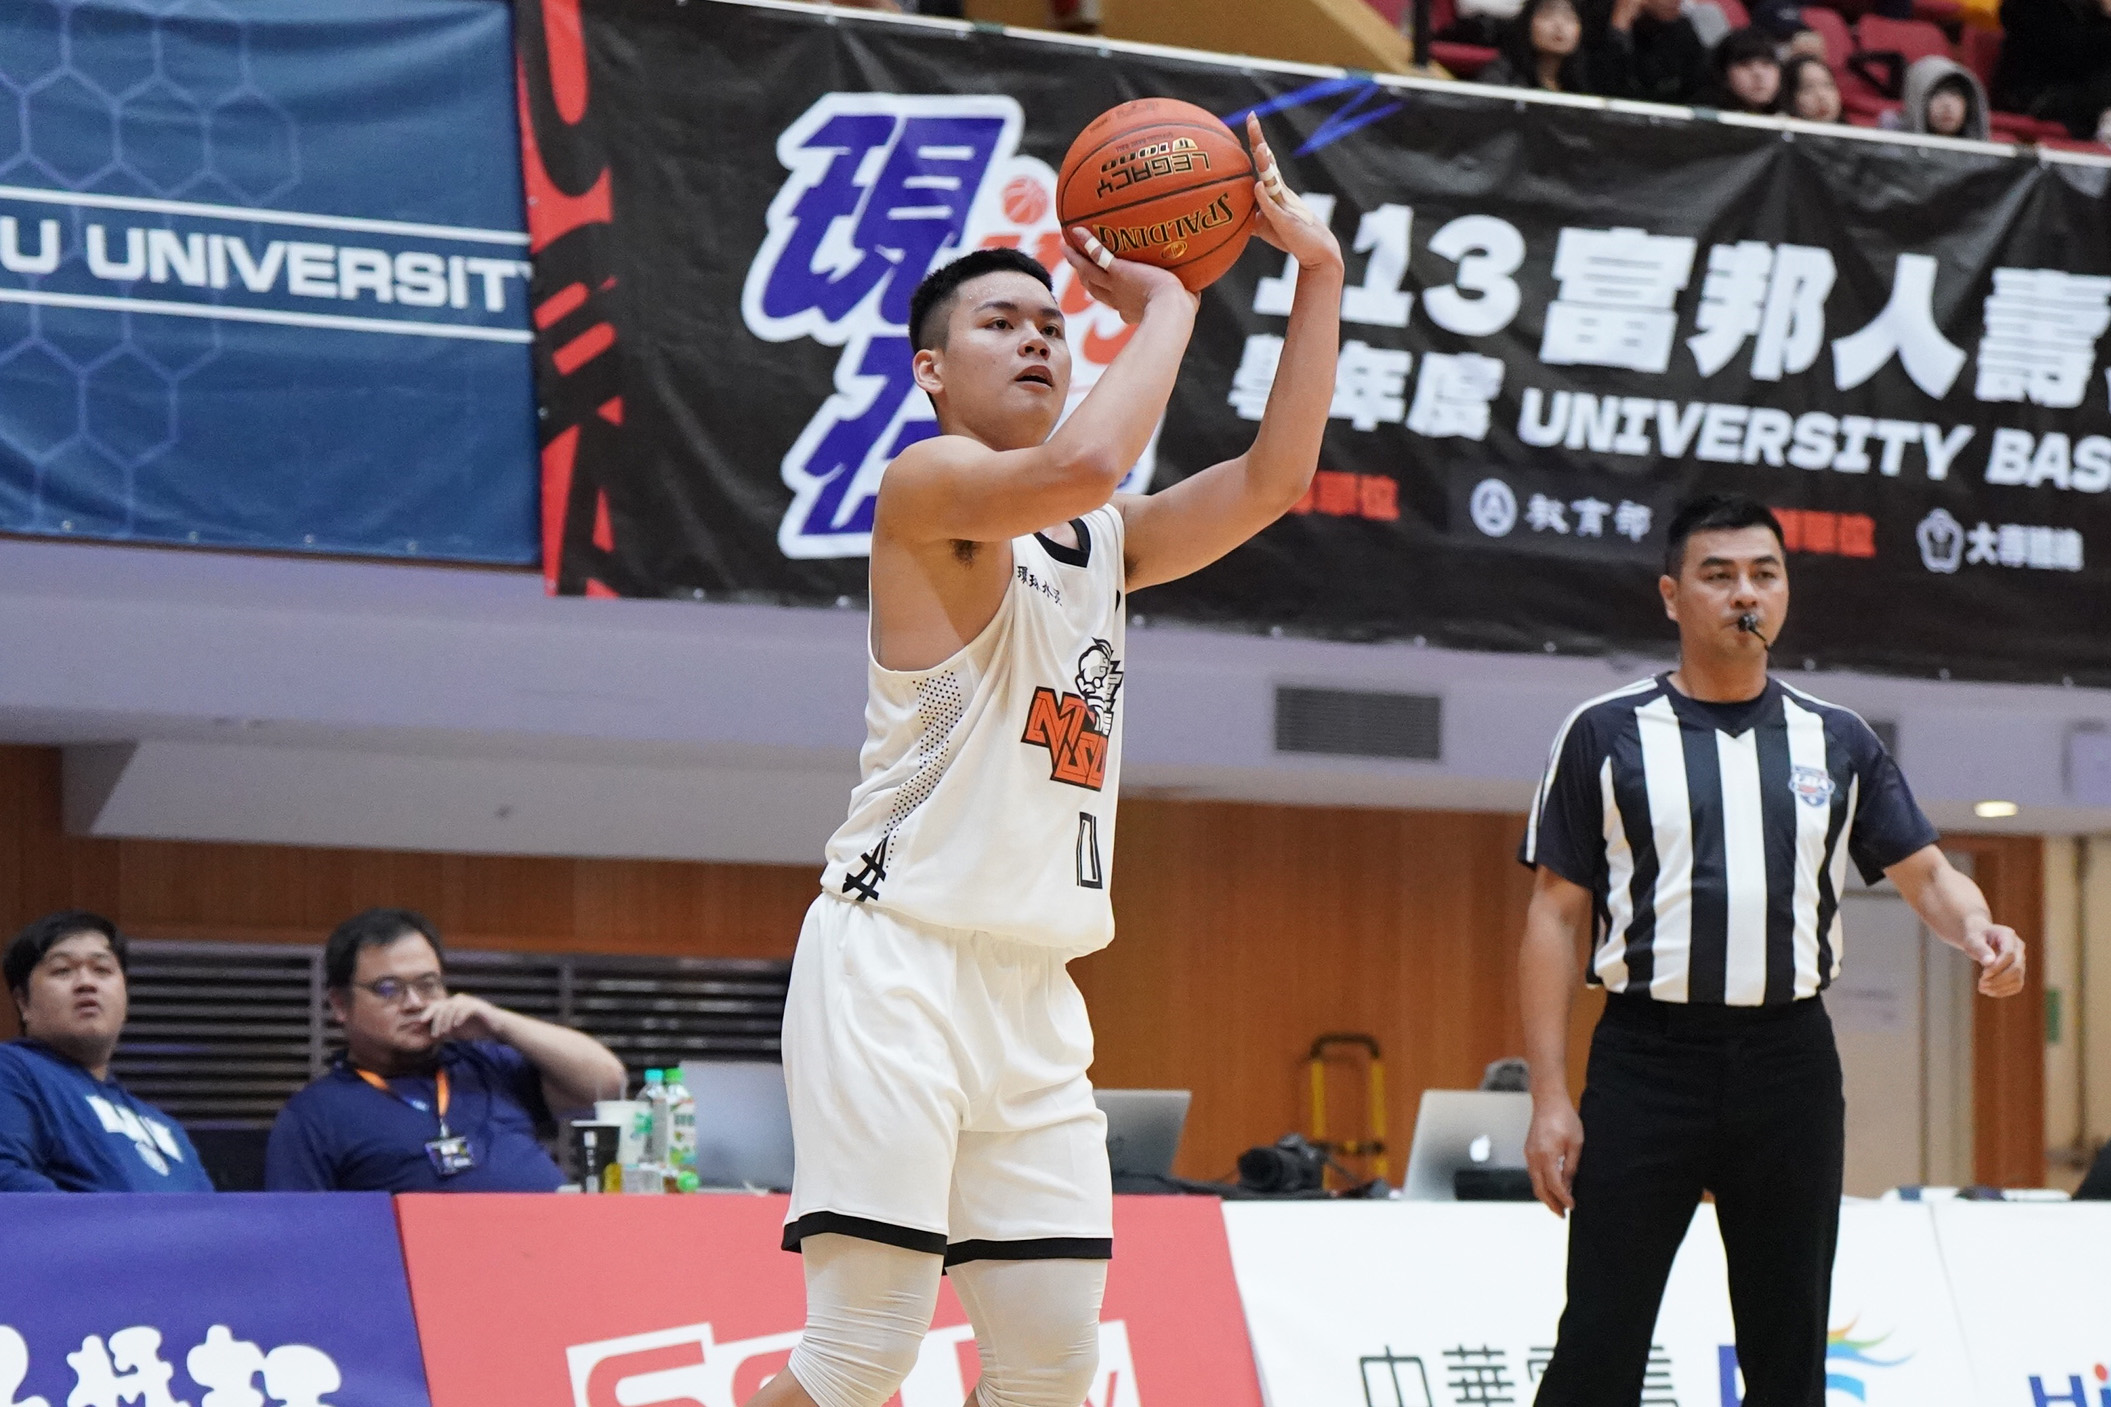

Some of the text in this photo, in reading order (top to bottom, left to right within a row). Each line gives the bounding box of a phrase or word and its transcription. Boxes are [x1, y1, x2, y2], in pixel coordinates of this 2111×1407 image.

[1096, 151, 1211, 199] LEGACY
[1093, 192, 1233, 254] SPALDING
[1540, 227, 2111, 409] 富邦人壽
[1518, 388, 1976, 480] UNIVERSITY
[1360, 1344, 1680, 1407] 中華
